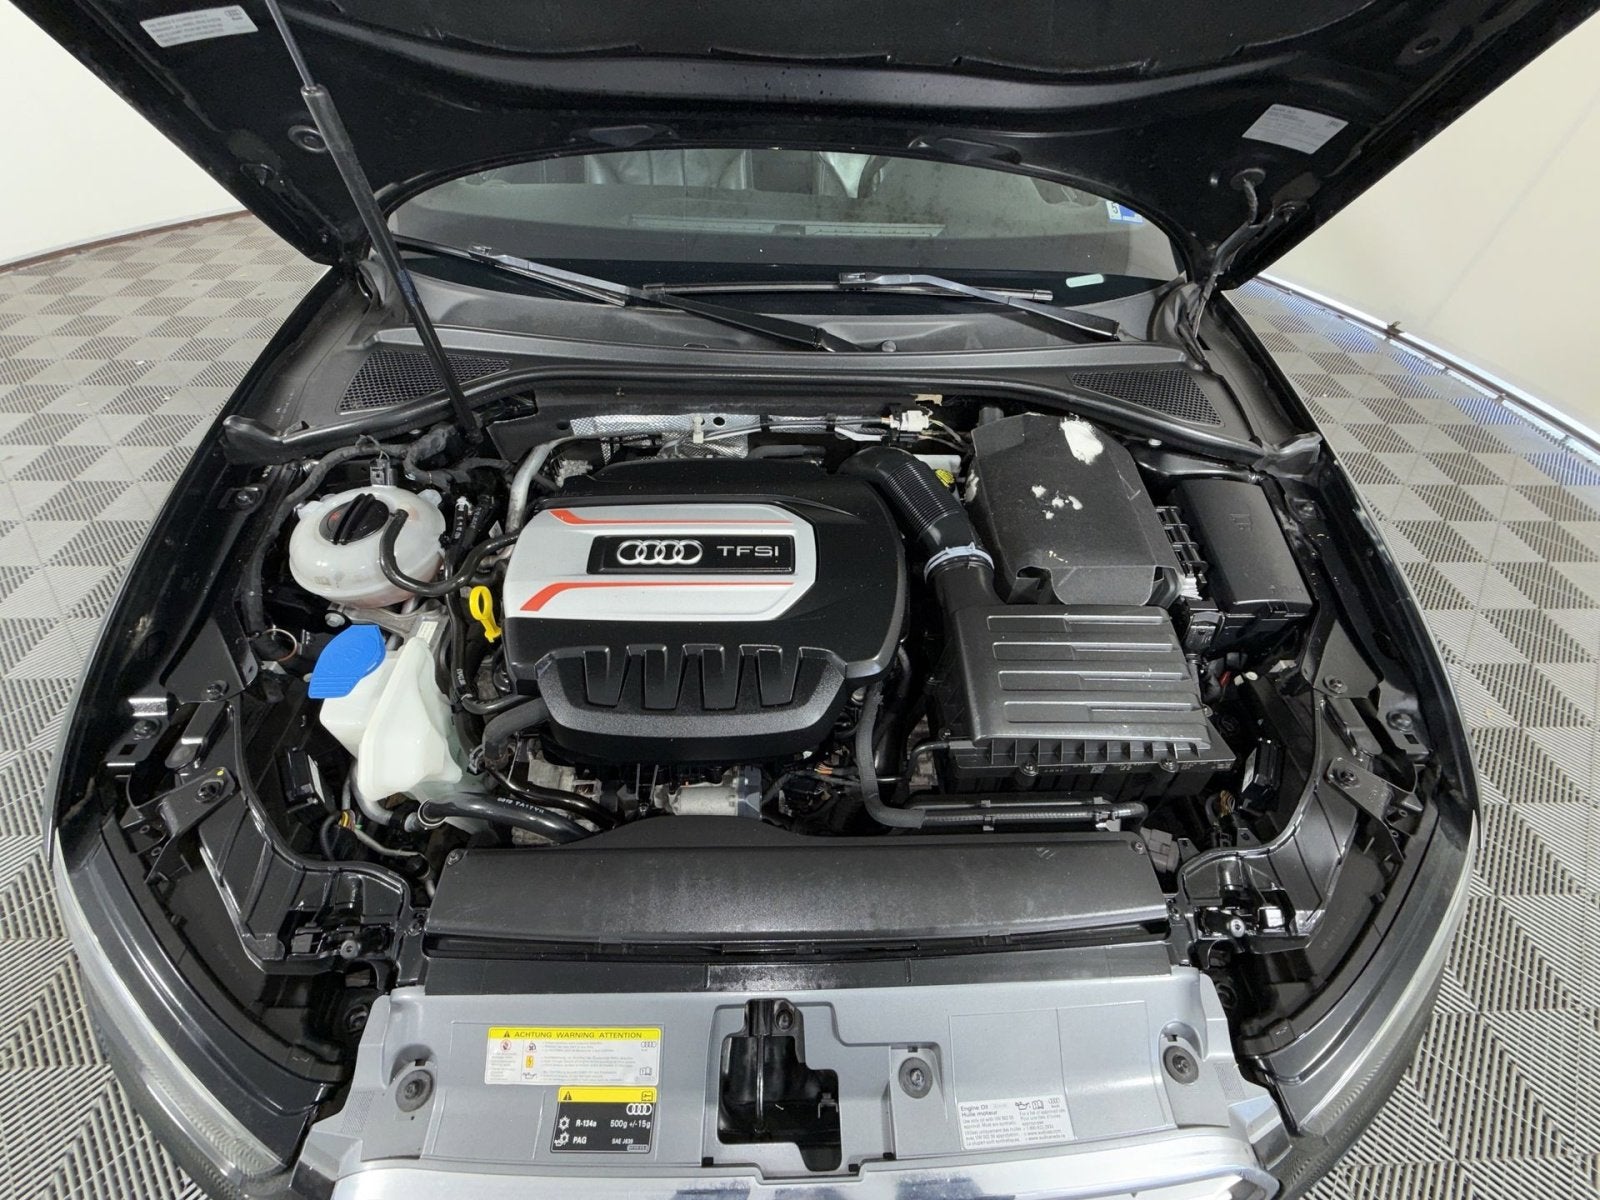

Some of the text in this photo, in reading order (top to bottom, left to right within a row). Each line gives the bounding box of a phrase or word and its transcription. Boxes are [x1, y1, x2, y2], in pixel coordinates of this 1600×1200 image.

[716, 545, 779, 557] TFSI
[514, 1031, 642, 1039] ACHTUNG WARNING ATTENTION
[575, 1119, 597, 1128] R-134a
[610, 1119, 628, 1129] 500g
[572, 1136, 587, 1144] PAG
